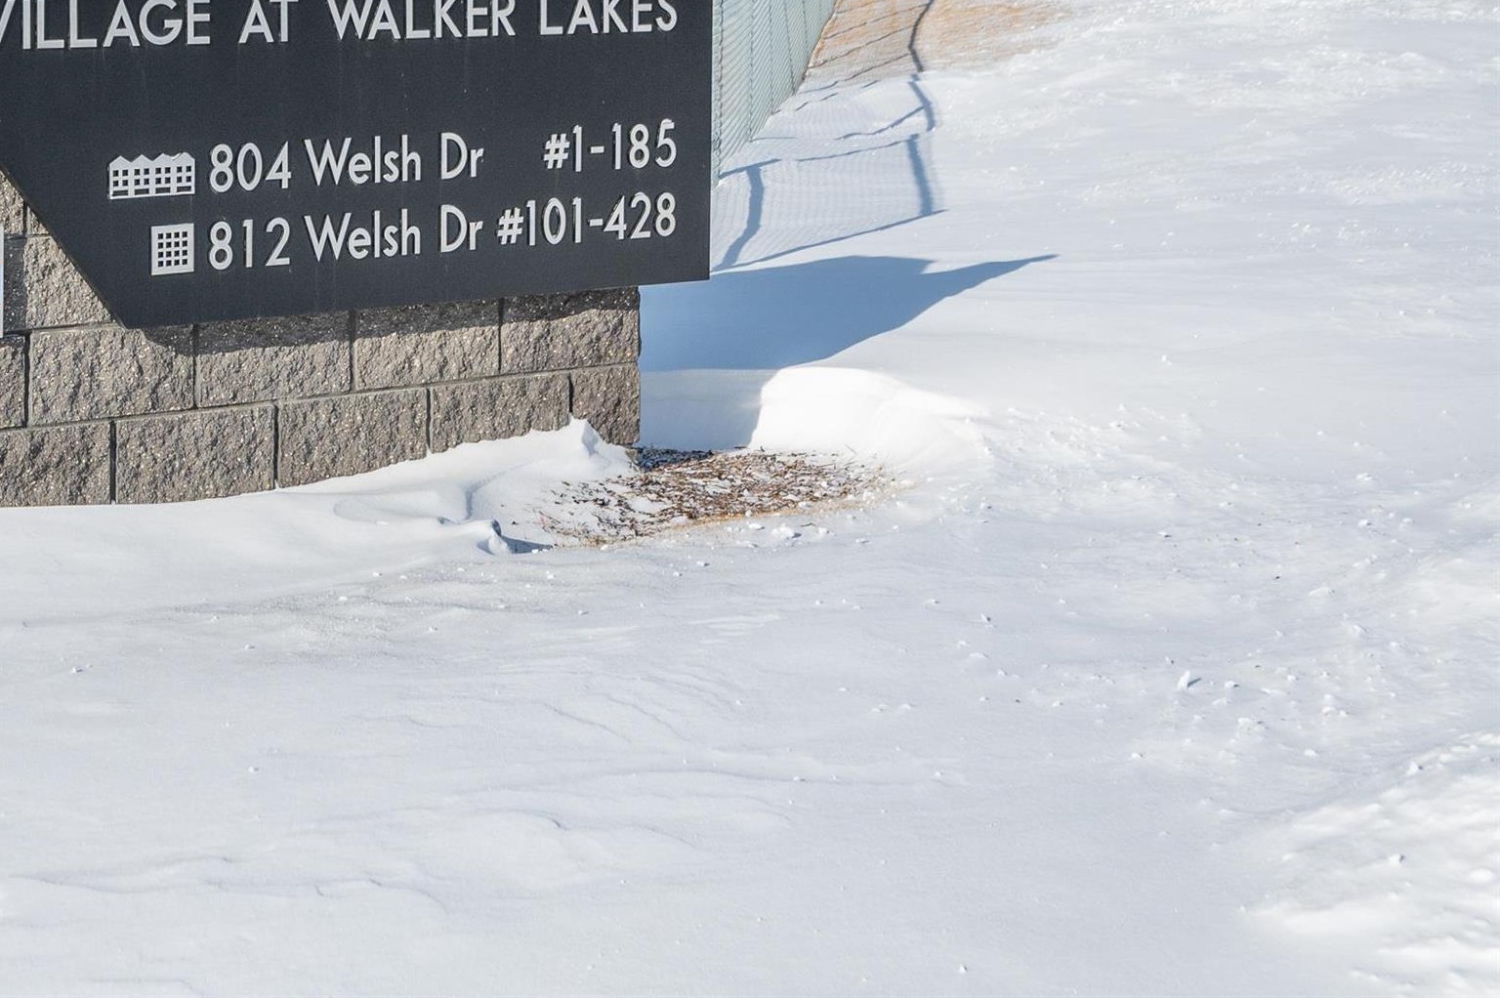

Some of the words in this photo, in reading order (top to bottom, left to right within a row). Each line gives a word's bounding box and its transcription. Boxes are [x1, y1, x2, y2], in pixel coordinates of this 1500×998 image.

[209, 141, 292, 193] 804
[304, 134, 421, 186] Welsh
[440, 131, 484, 180] Dr
[543, 118, 677, 173] #1-185
[209, 217, 291, 270] 812
[304, 208, 421, 262] Welsh
[440, 204, 484, 253] Dr
[496, 192, 678, 247] #101-428
